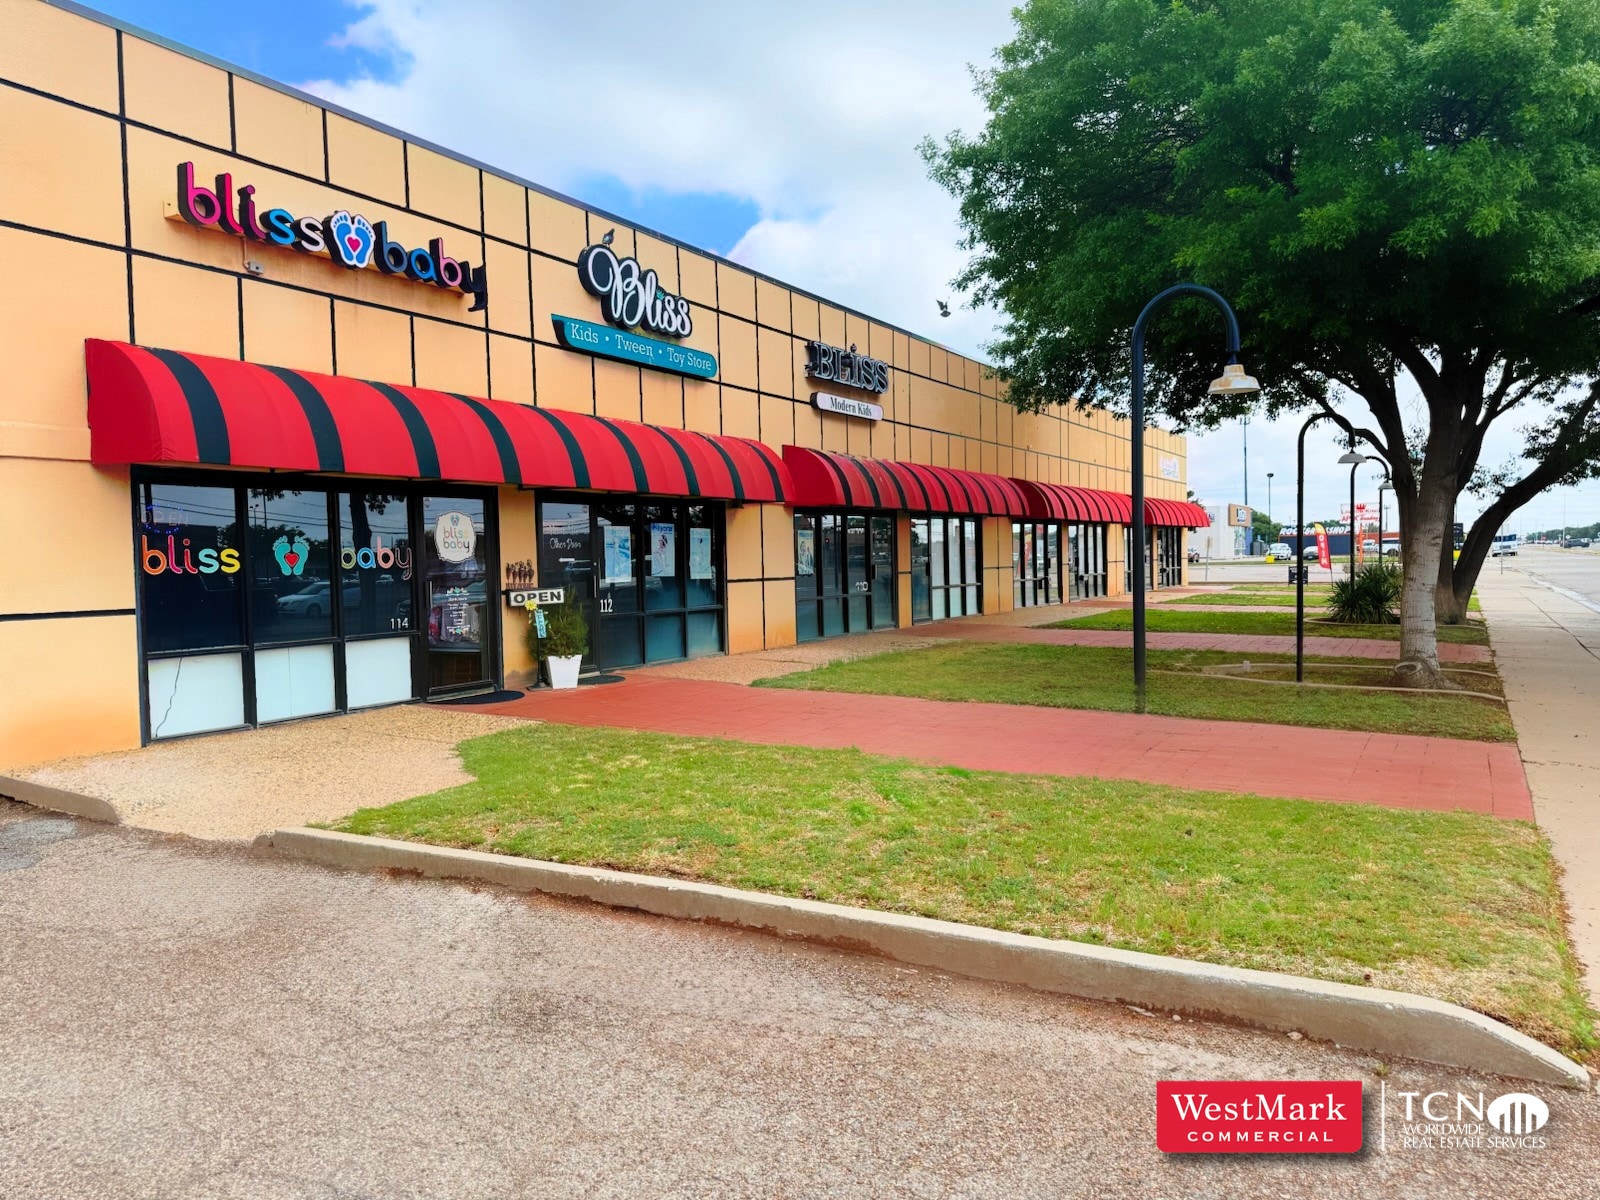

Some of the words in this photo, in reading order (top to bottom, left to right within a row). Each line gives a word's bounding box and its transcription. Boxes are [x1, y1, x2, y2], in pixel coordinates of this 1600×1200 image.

[177, 161, 325, 252] bliss
[374, 221, 487, 312] baby
[587, 248, 691, 336] Bliss
[571, 323, 599, 344] Kids
[615, 334, 653, 357] Tween
[667, 348, 685, 368] Toy
[687, 354, 712, 371] Store
[809, 342, 889, 394] BLISS
[830, 397, 857, 413] Modern
[858, 403, 873, 417] Kids
[443, 527, 469, 540] bliss
[443, 537, 470, 553] baby
[142, 535, 240, 575] bliss
[341, 536, 412, 580] baby
[514, 591, 561, 604] OPEN
[600, 598, 613, 613] 112
[389, 617, 409, 631] 114
